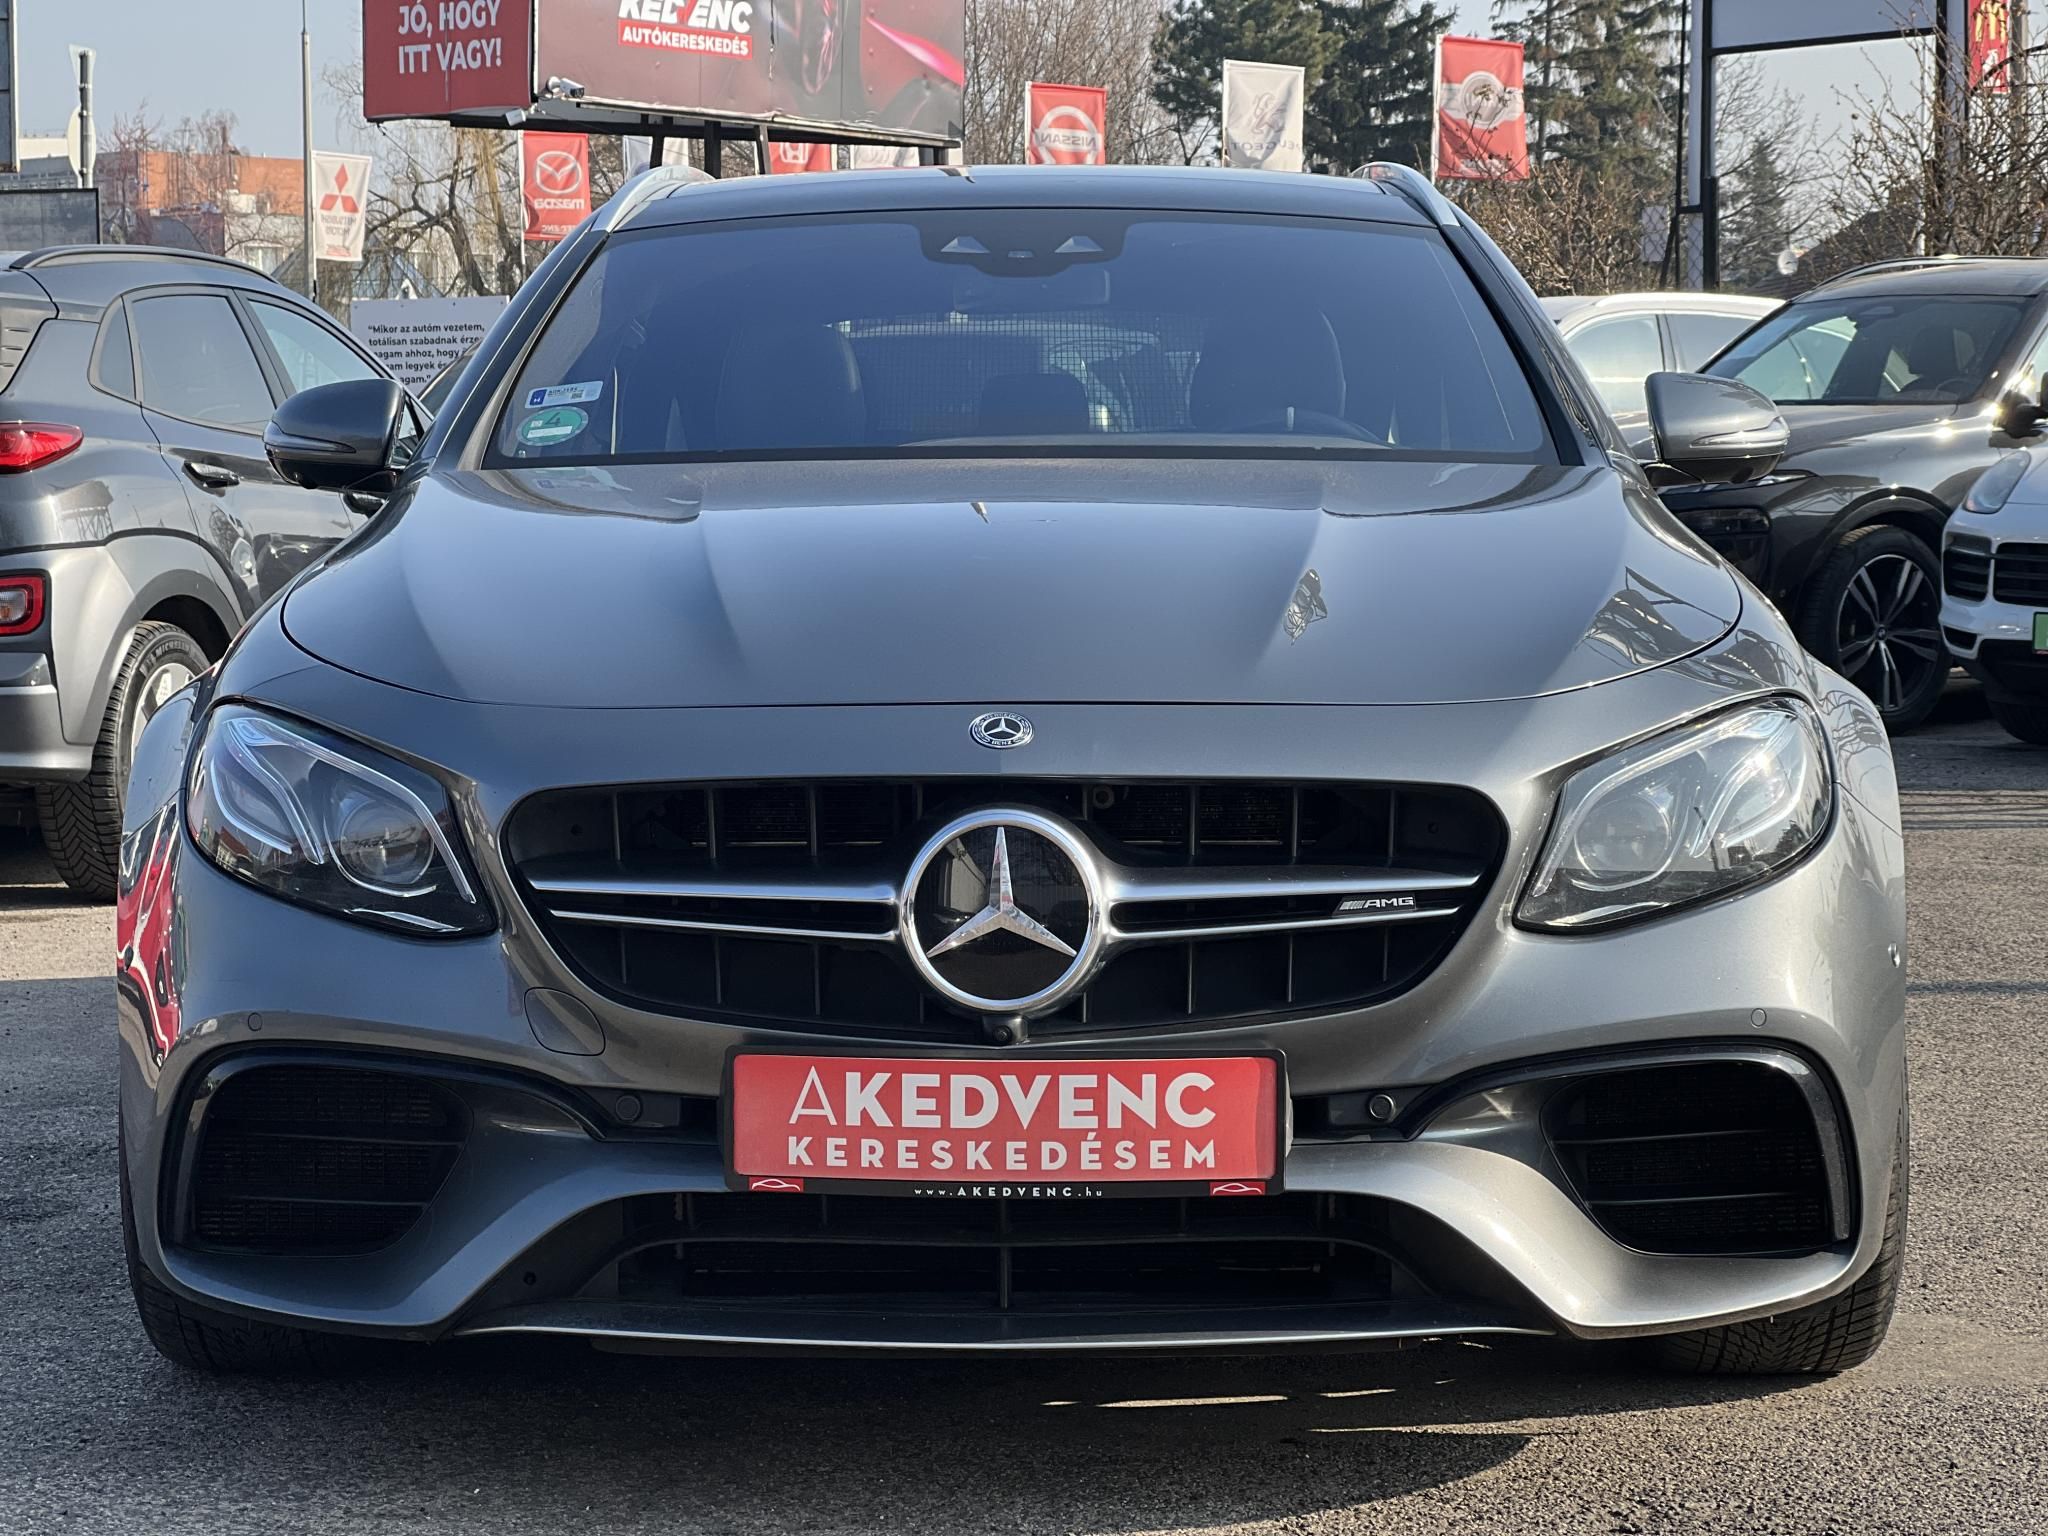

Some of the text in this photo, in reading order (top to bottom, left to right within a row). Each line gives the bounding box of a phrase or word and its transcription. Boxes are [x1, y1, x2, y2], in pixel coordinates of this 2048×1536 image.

[398, 0, 501, 38] JÓ, HOGY
[622, 25, 749, 56] AUTÓKERESKEDÉS
[398, 37, 502, 74] ITT VAGY!
[412, 323, 441, 332] autóm
[444, 323, 485, 333] vezetem,
[369, 337, 407, 346] totálisan
[410, 336, 457, 345] szabadnak
[405, 349, 435, 359] ahhoz,
[437, 349, 459, 359] hogy
[405, 361, 435, 371] legyek
[545, 412, 561, 426] 4
[1364, 896, 1414, 909] AMG
[789, 1065, 1216, 1130] AKEDVENC
[788, 1131, 1215, 1170] KERESKEDÉSEM
[914, 1186, 1102, 1197] www.AKEDVENC.hu
